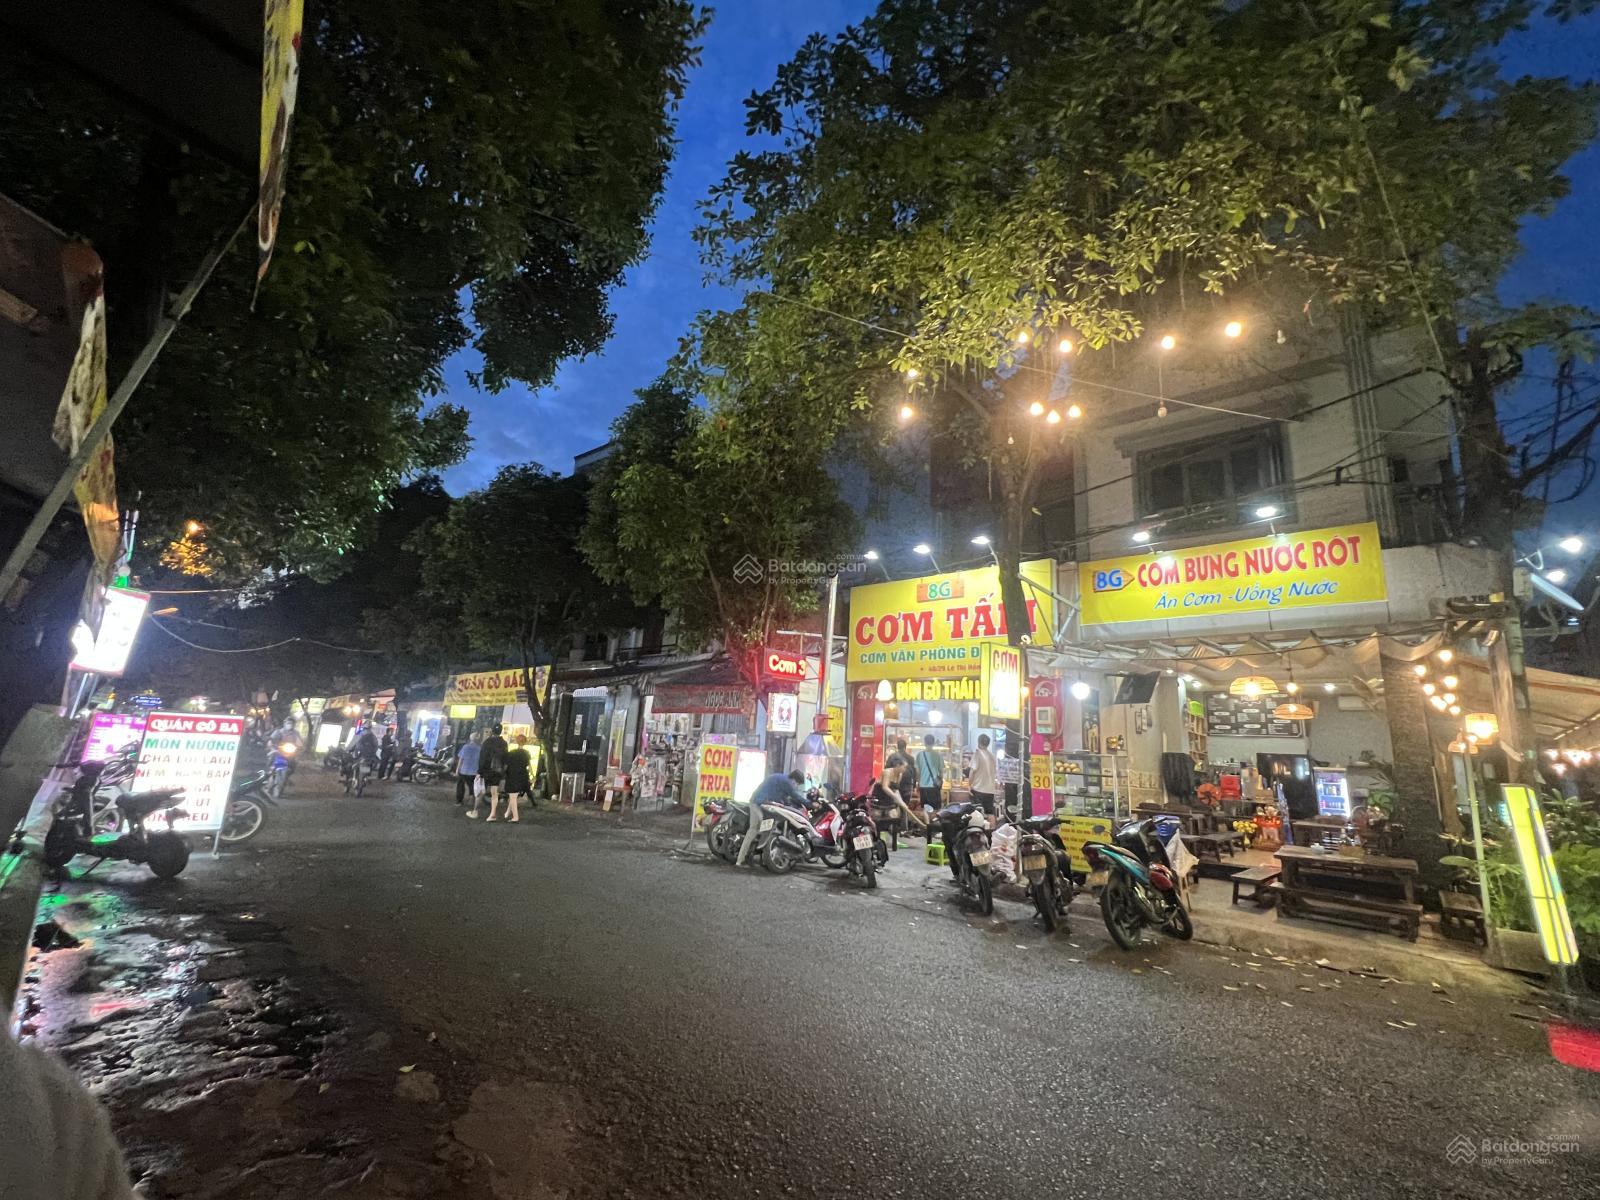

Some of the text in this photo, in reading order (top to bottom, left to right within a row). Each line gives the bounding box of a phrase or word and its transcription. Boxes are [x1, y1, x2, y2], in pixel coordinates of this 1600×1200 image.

[1096, 569, 1122, 589] 8G
[928, 581, 951, 599] 8G
[855, 611, 934, 646] CƠM
[151, 718, 194, 732] QUÁN
